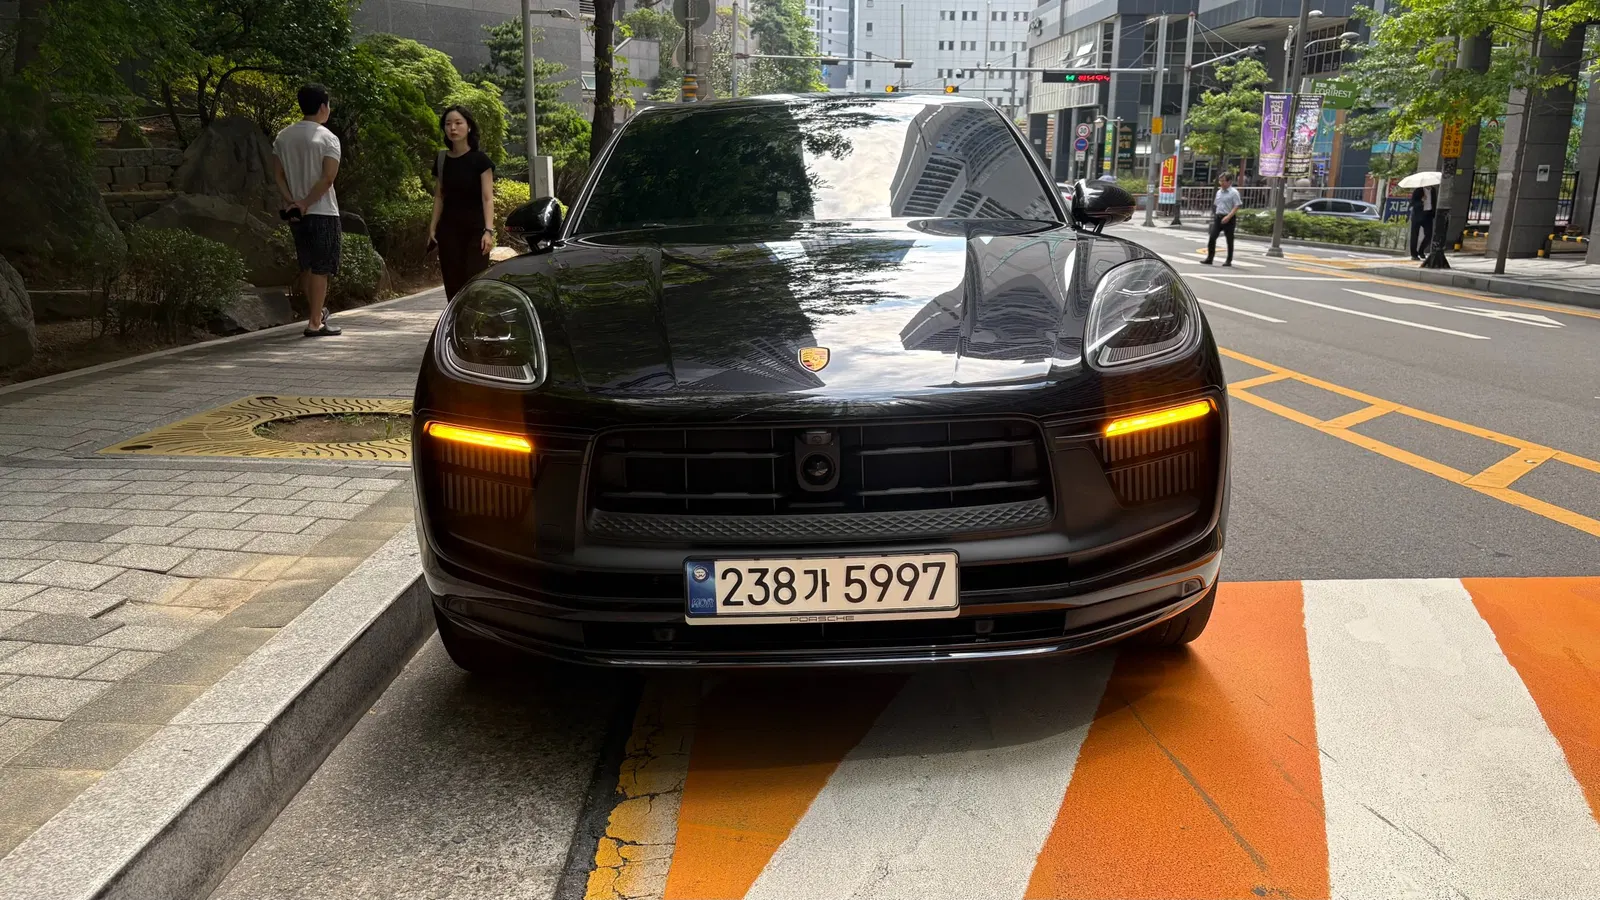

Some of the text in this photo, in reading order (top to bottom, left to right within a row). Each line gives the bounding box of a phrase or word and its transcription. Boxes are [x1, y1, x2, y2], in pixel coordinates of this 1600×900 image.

[1163, 157, 1175, 190] 세탁
[721, 561, 947, 607] 238가 5997
[691, 597, 715, 608] KOR
